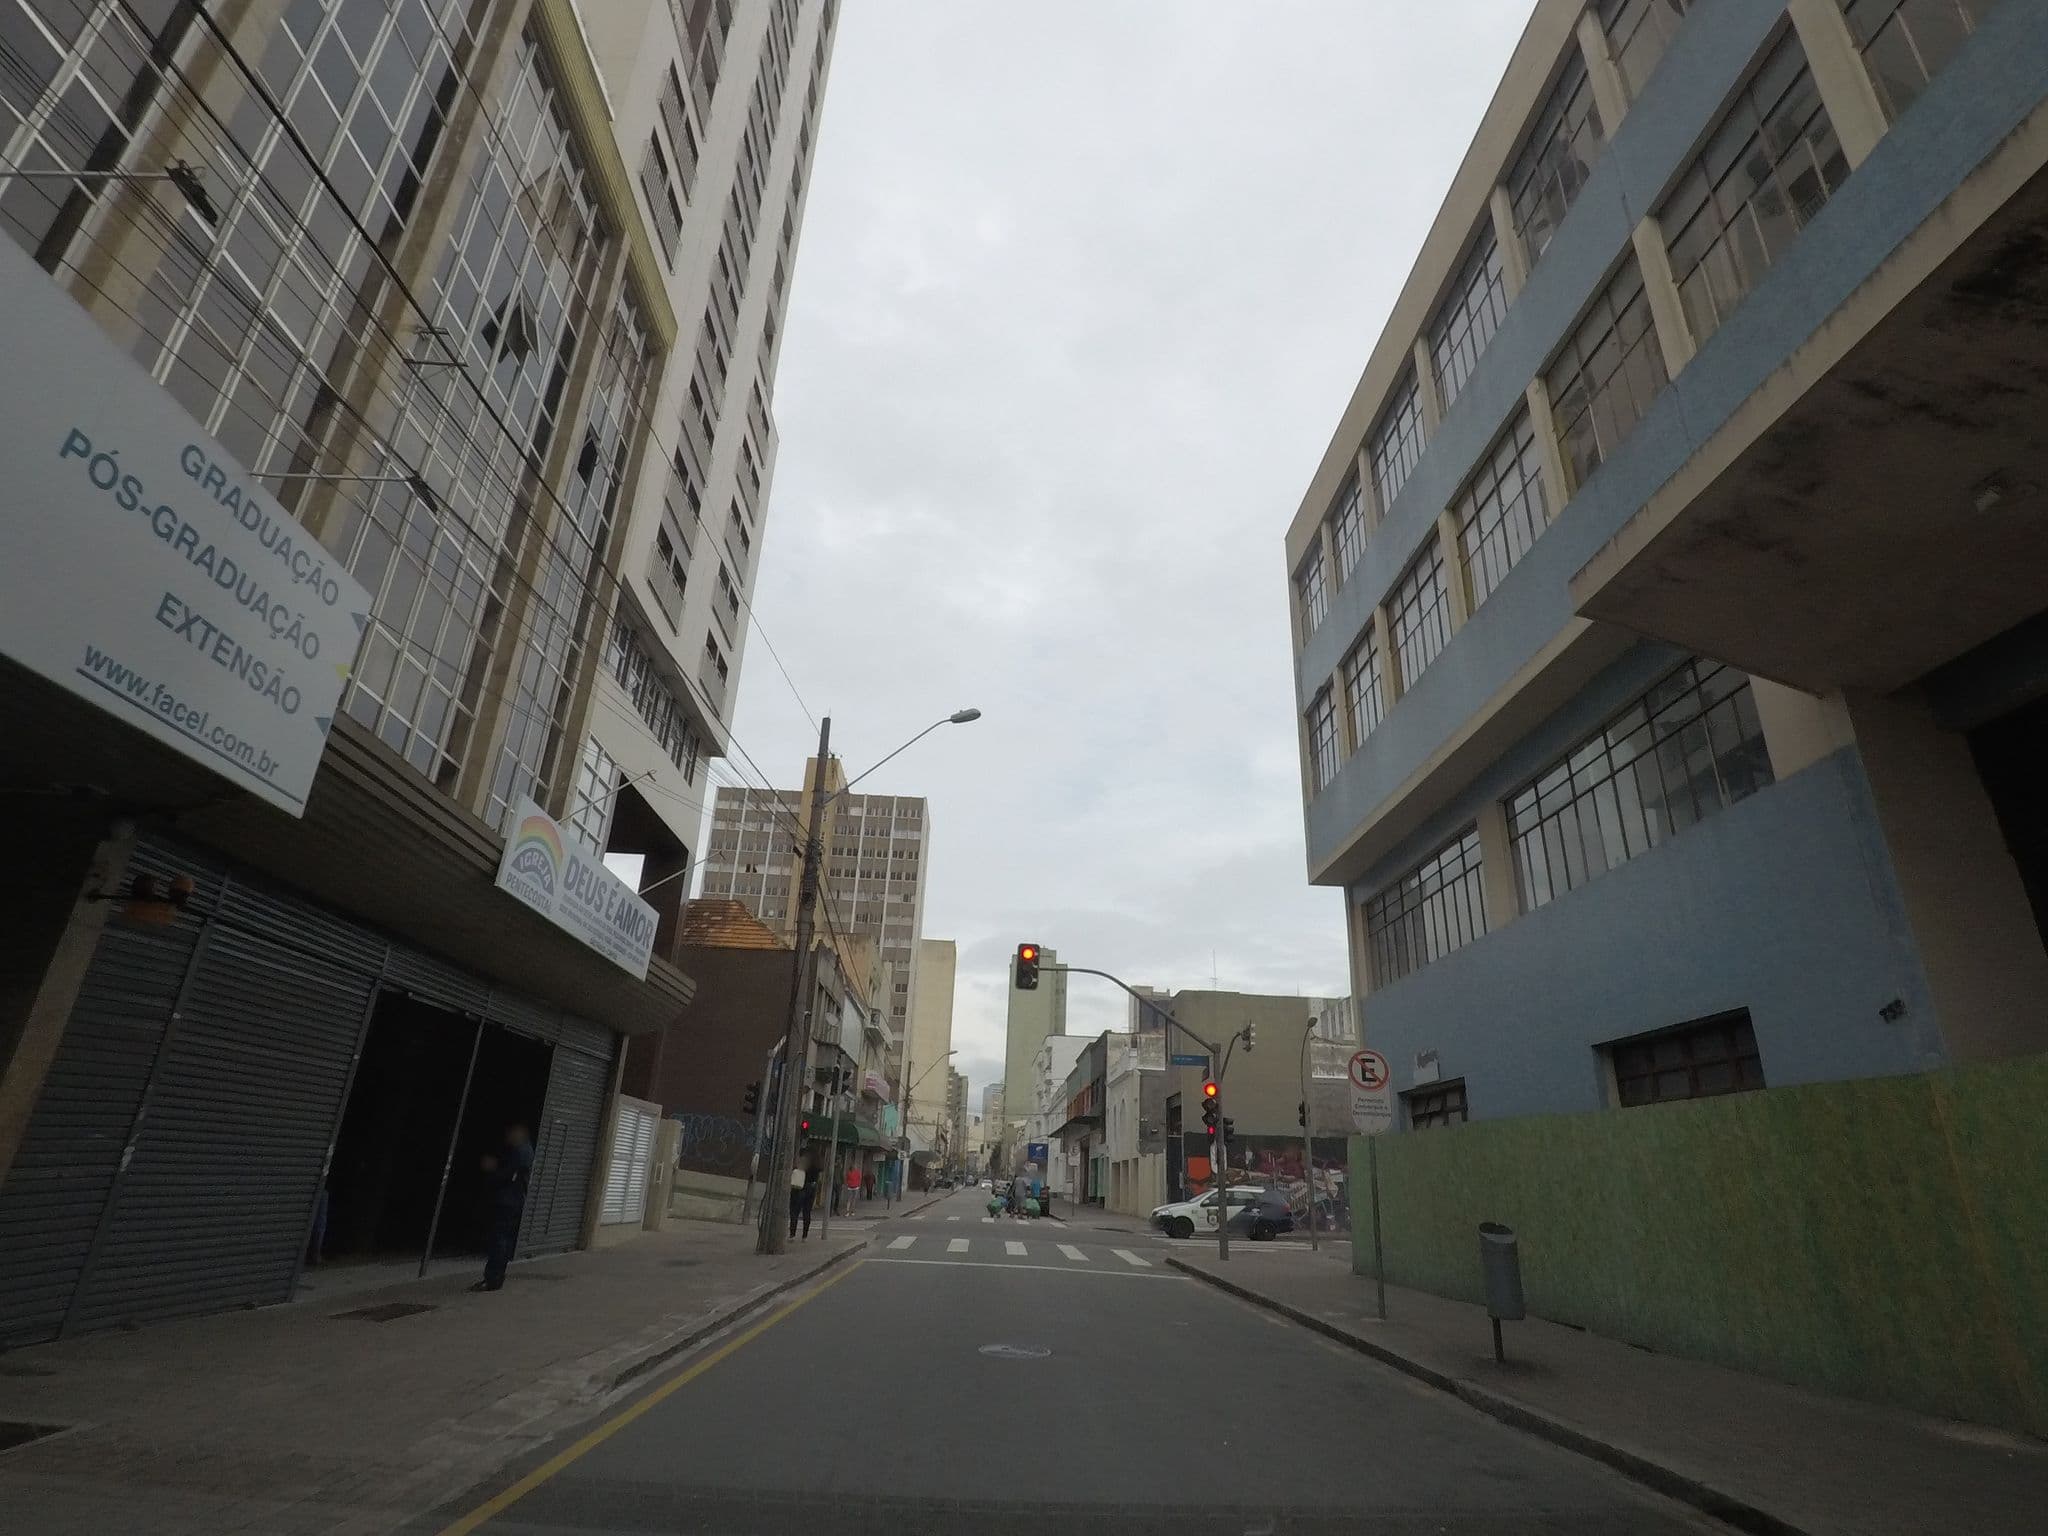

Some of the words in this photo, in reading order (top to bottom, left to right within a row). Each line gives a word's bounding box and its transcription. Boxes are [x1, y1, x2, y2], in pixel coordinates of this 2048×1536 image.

[59, 428, 320, 660] PÓS-GRADUAÇÃO
[180, 444, 340, 606] GRADUAÇÃO
[155, 592, 301, 714] EXTENSÃO
[85, 645, 280, 777] www.facel.com.br
[505, 872, 551, 911] PENTECOSTAL
[519, 851, 551, 887] IGREJA
[564, 855, 607, 912] DEUS
[605, 881, 620, 921] É
[614, 897, 654, 949] AMOR
[1361, 1058, 1377, 1082] E
